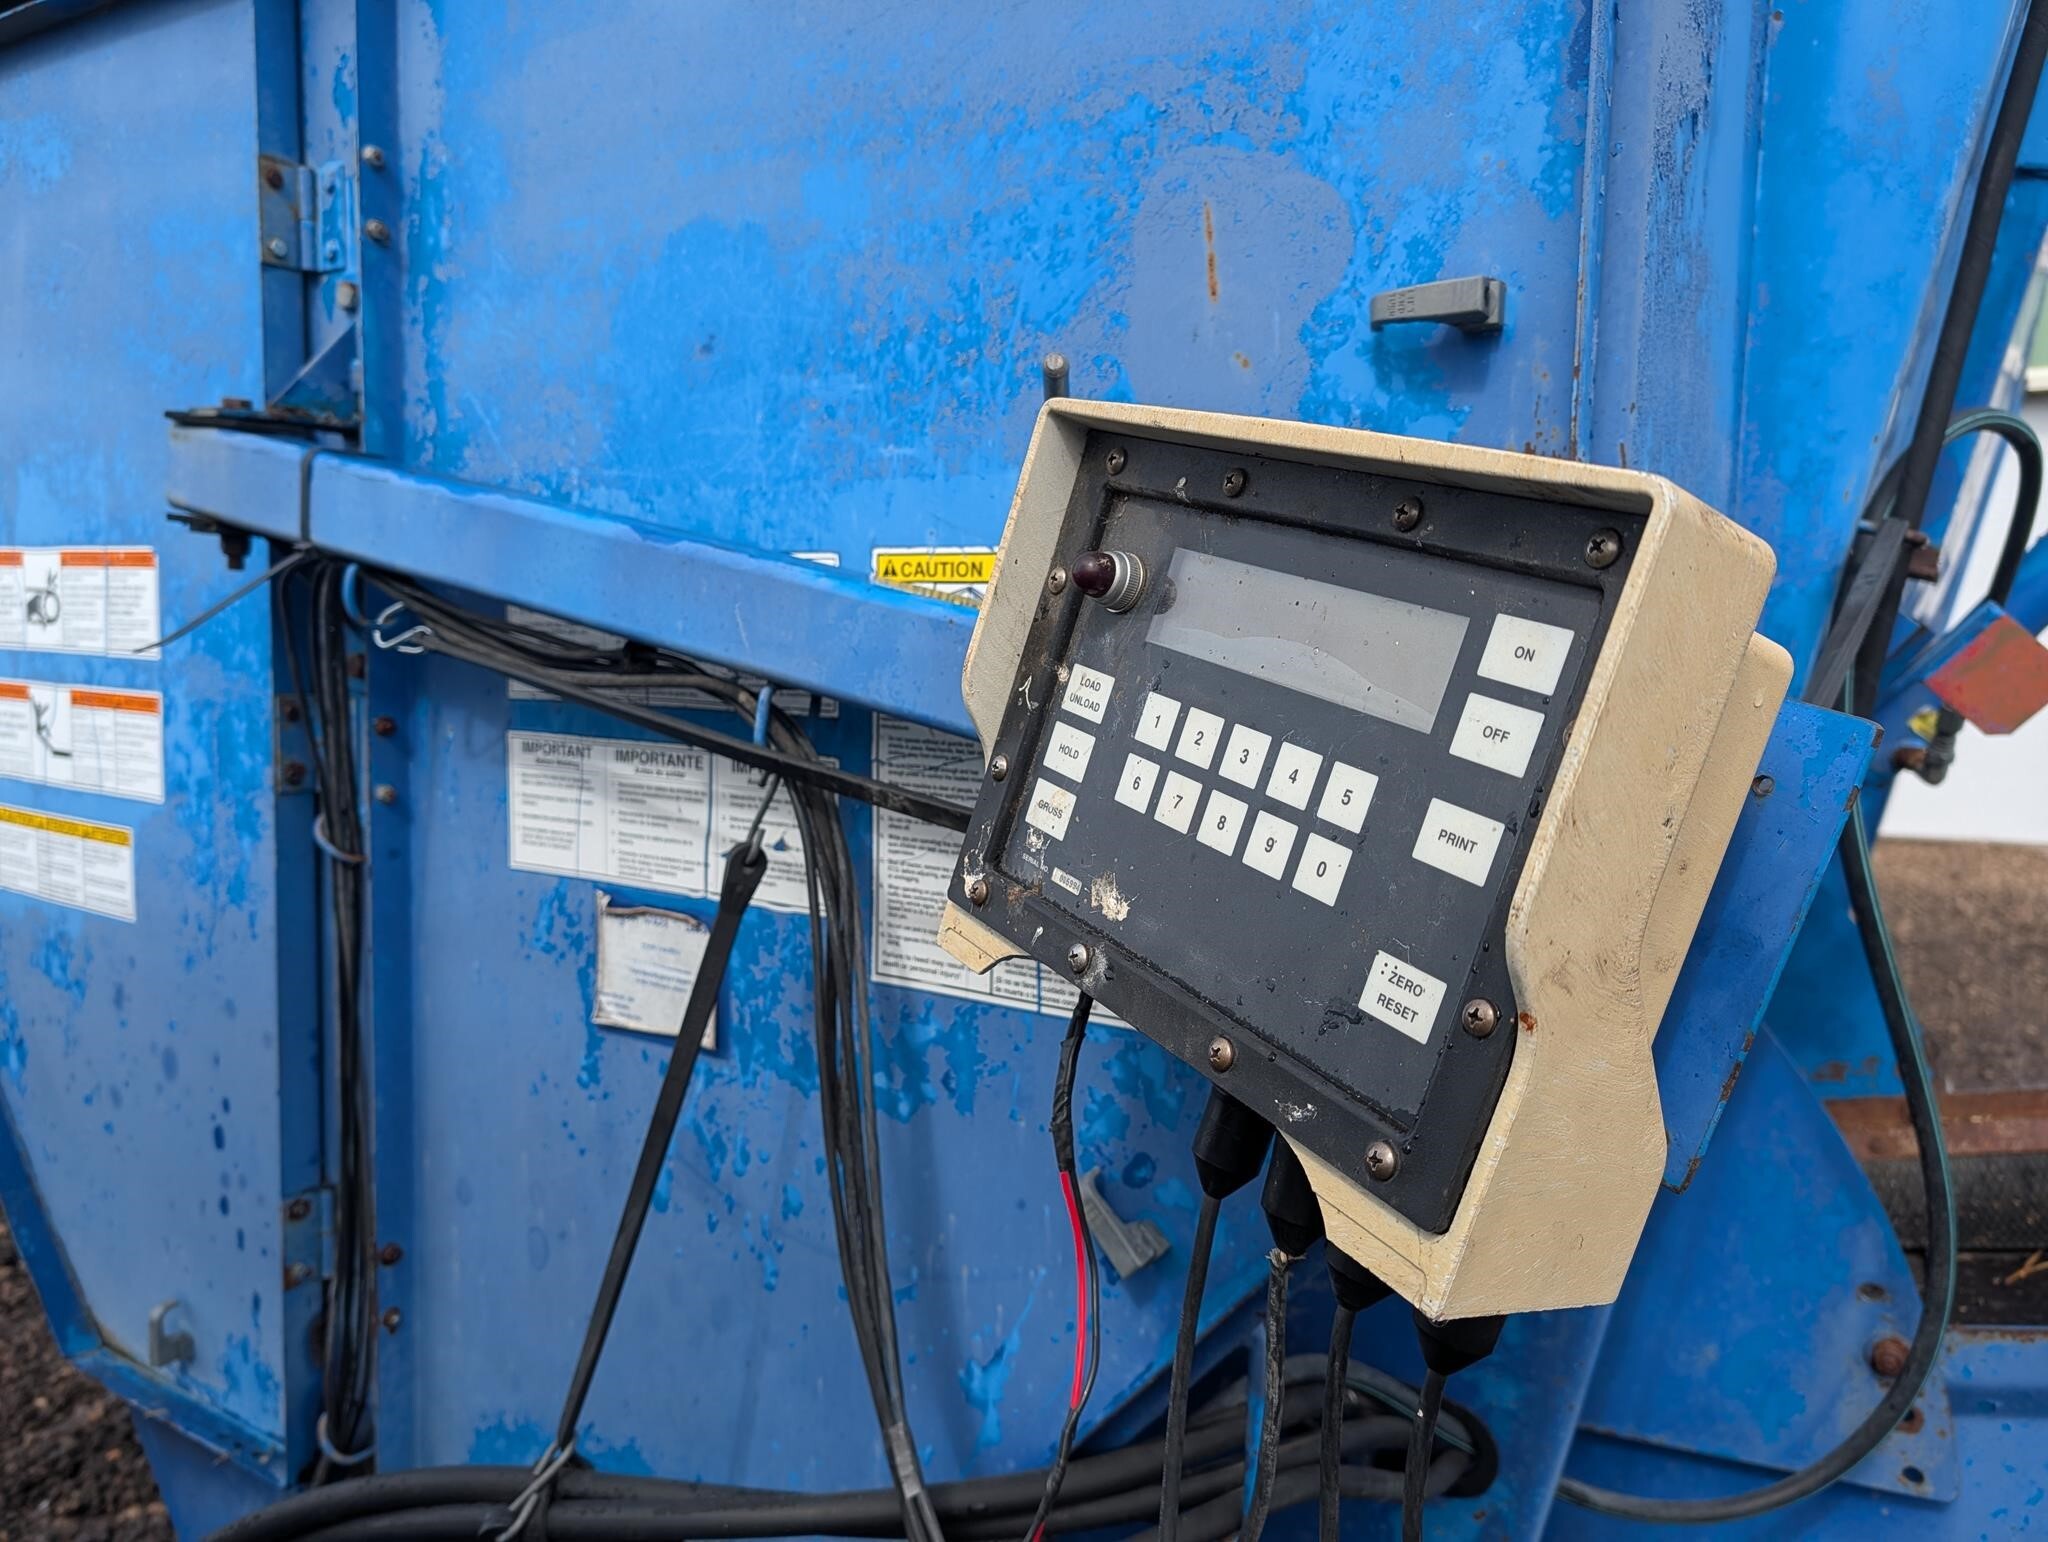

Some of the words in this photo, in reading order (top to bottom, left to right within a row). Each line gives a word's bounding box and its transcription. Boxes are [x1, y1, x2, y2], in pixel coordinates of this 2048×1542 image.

[900, 561, 983, 578] CAUTION
[1514, 646, 1535, 662] ON
[1079, 677, 1102, 692] LOAD
[1069, 692, 1101, 712] UNLOAD
[1482, 725, 1511, 743] OFF
[521, 741, 592, 759] IMPORTANT
[1058, 743, 1080, 760] HOLD
[615, 749, 704, 771] IMPORTANTE
[1154, 715, 1161, 728] 1
[1194, 731, 1204, 746] 2
[1239, 749, 1249, 764] 3
[1289, 768, 1299, 784] 4
[1341, 789, 1353, 806] 5
[1132, 776, 1142, 791] 6
[1174, 795, 1184, 809] 7
[1217, 815, 1227, 830] 8
[1264, 836, 1275, 853] 9
[1316, 861, 1327, 878] 0
[1437, 829, 1478, 854] PRINT
[1022, 853, 1040, 868] SERIAL
[1388, 970, 1424, 997] ZERO
[1377, 993, 1419, 1024] RESET
